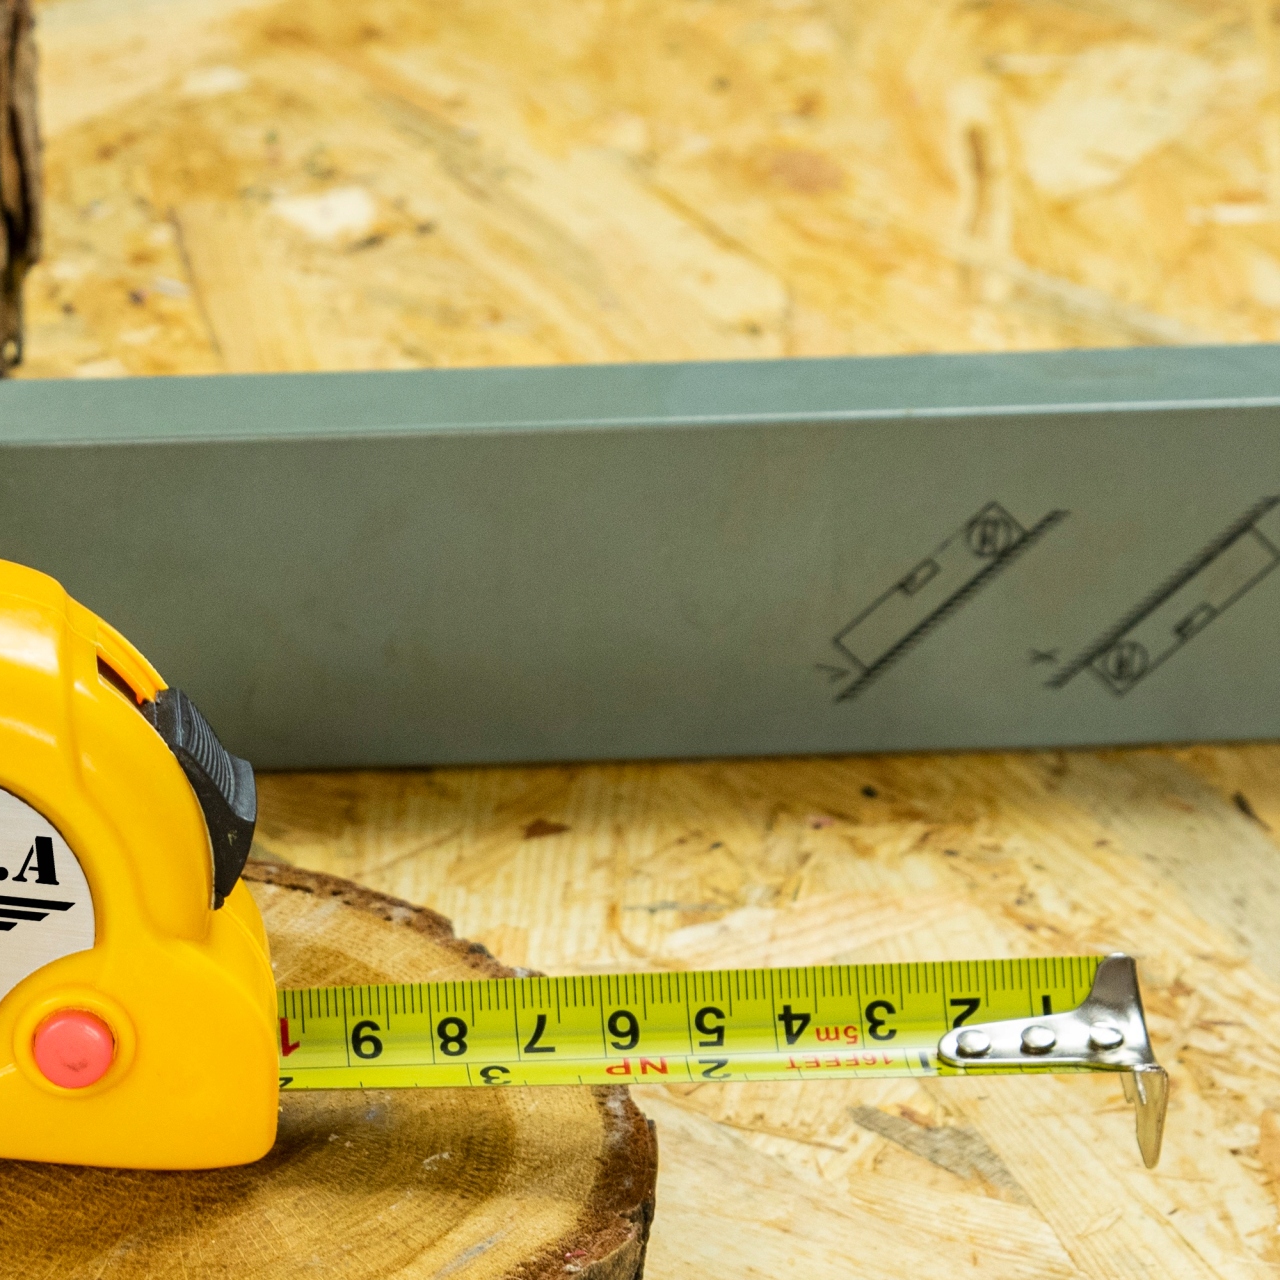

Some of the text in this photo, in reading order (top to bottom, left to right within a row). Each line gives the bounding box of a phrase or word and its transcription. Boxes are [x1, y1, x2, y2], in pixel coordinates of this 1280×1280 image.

[351, 1020, 383, 1059] 9
[437, 1016, 468, 1056] 8
[524, 1014, 556, 1053] 7
[607, 1010, 640, 1051] 6
[694, 1006, 725, 1047] 5
[778, 1005, 811, 1045] 4
[815, 1025, 858, 1044] 5m
[865, 1000, 897, 1041] 3
[479, 1065, 512, 1085] 3
[605, 1056, 669, 1076] NP
[698, 1058, 732, 1080] 2
